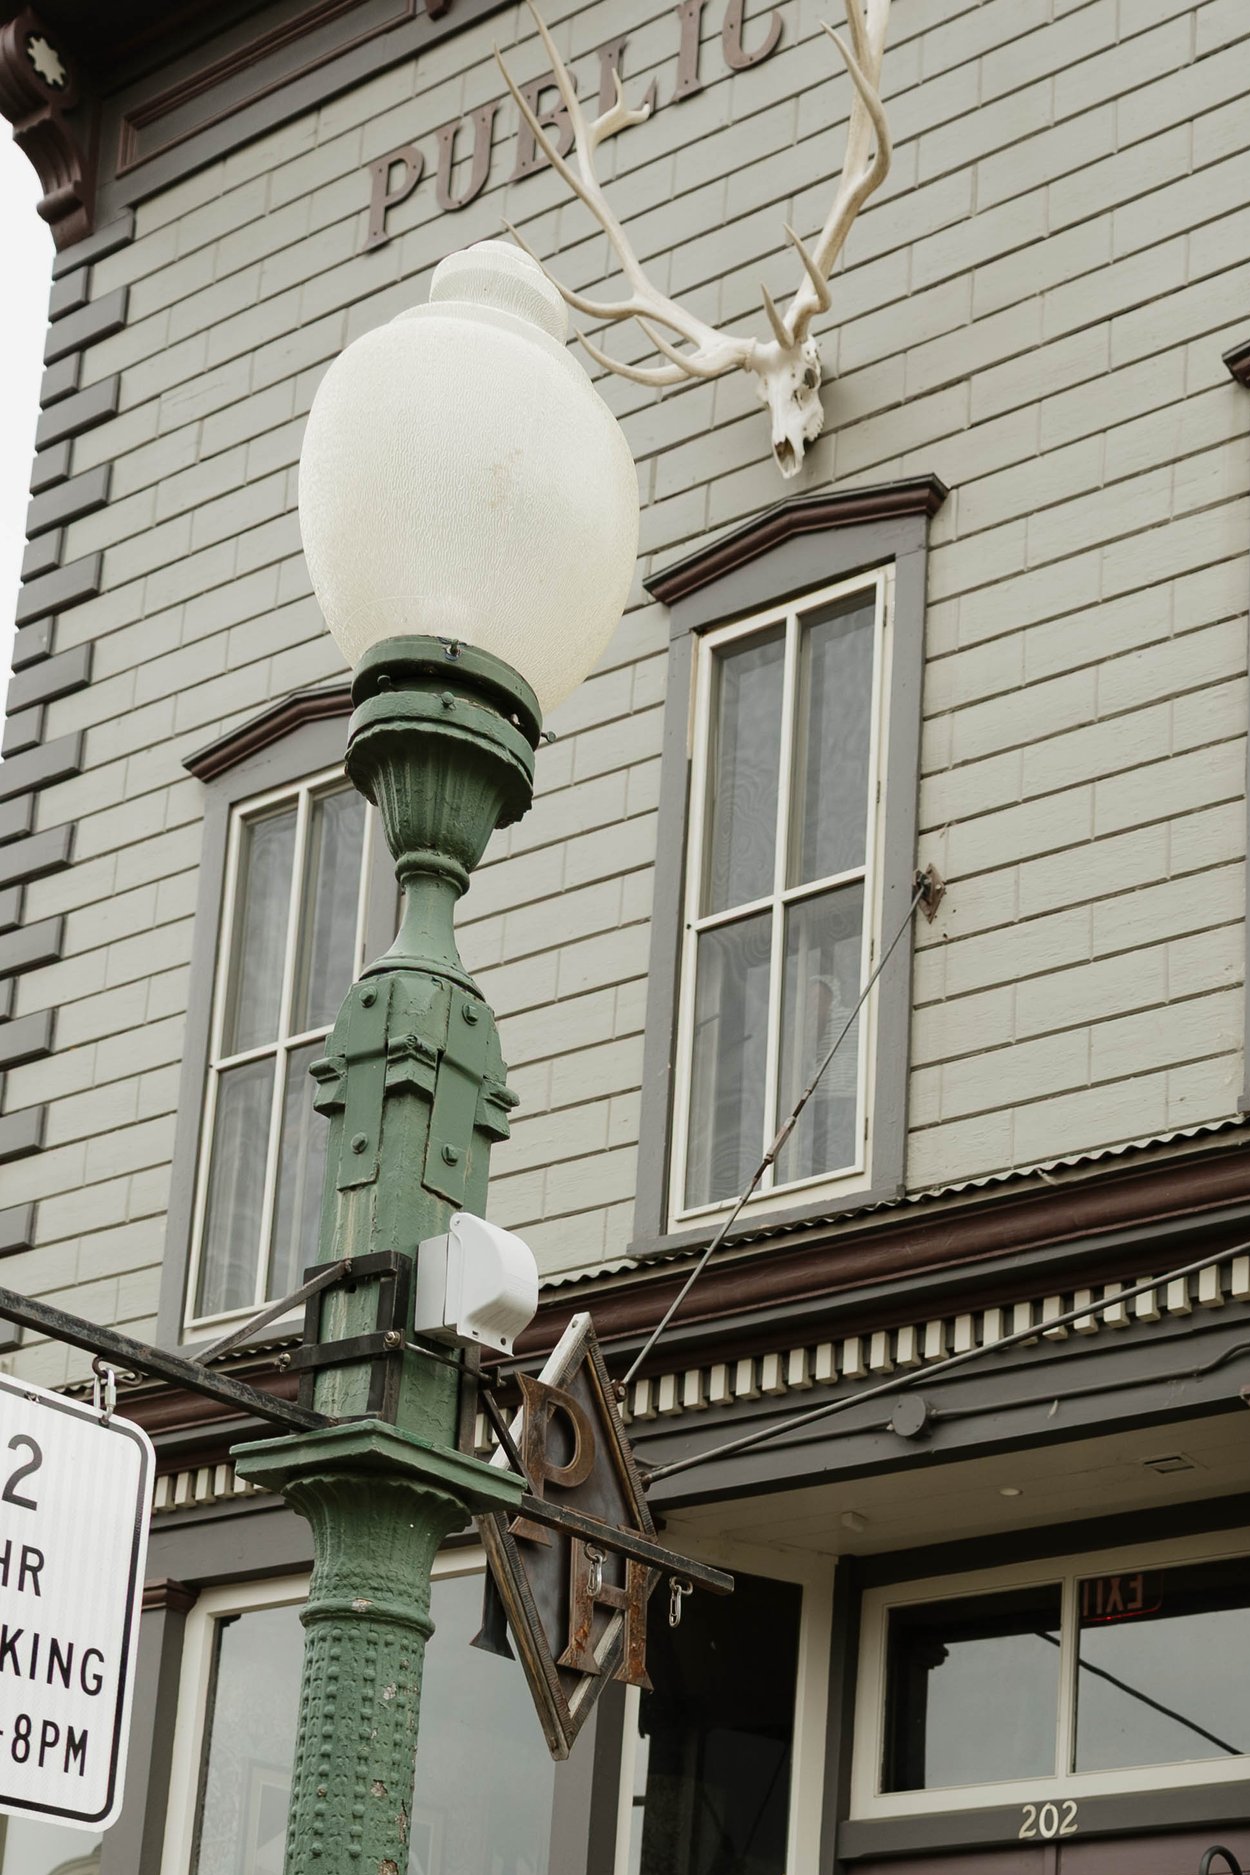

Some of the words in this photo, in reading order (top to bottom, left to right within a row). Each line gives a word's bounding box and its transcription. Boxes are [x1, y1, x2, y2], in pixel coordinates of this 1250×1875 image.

[363, 0, 783, 255] PUBLIC
[2, 1433, 43, 1511] 2
[0, 1623, 104, 1696] KING
[1019, 1800, 1079, 1840] 202
